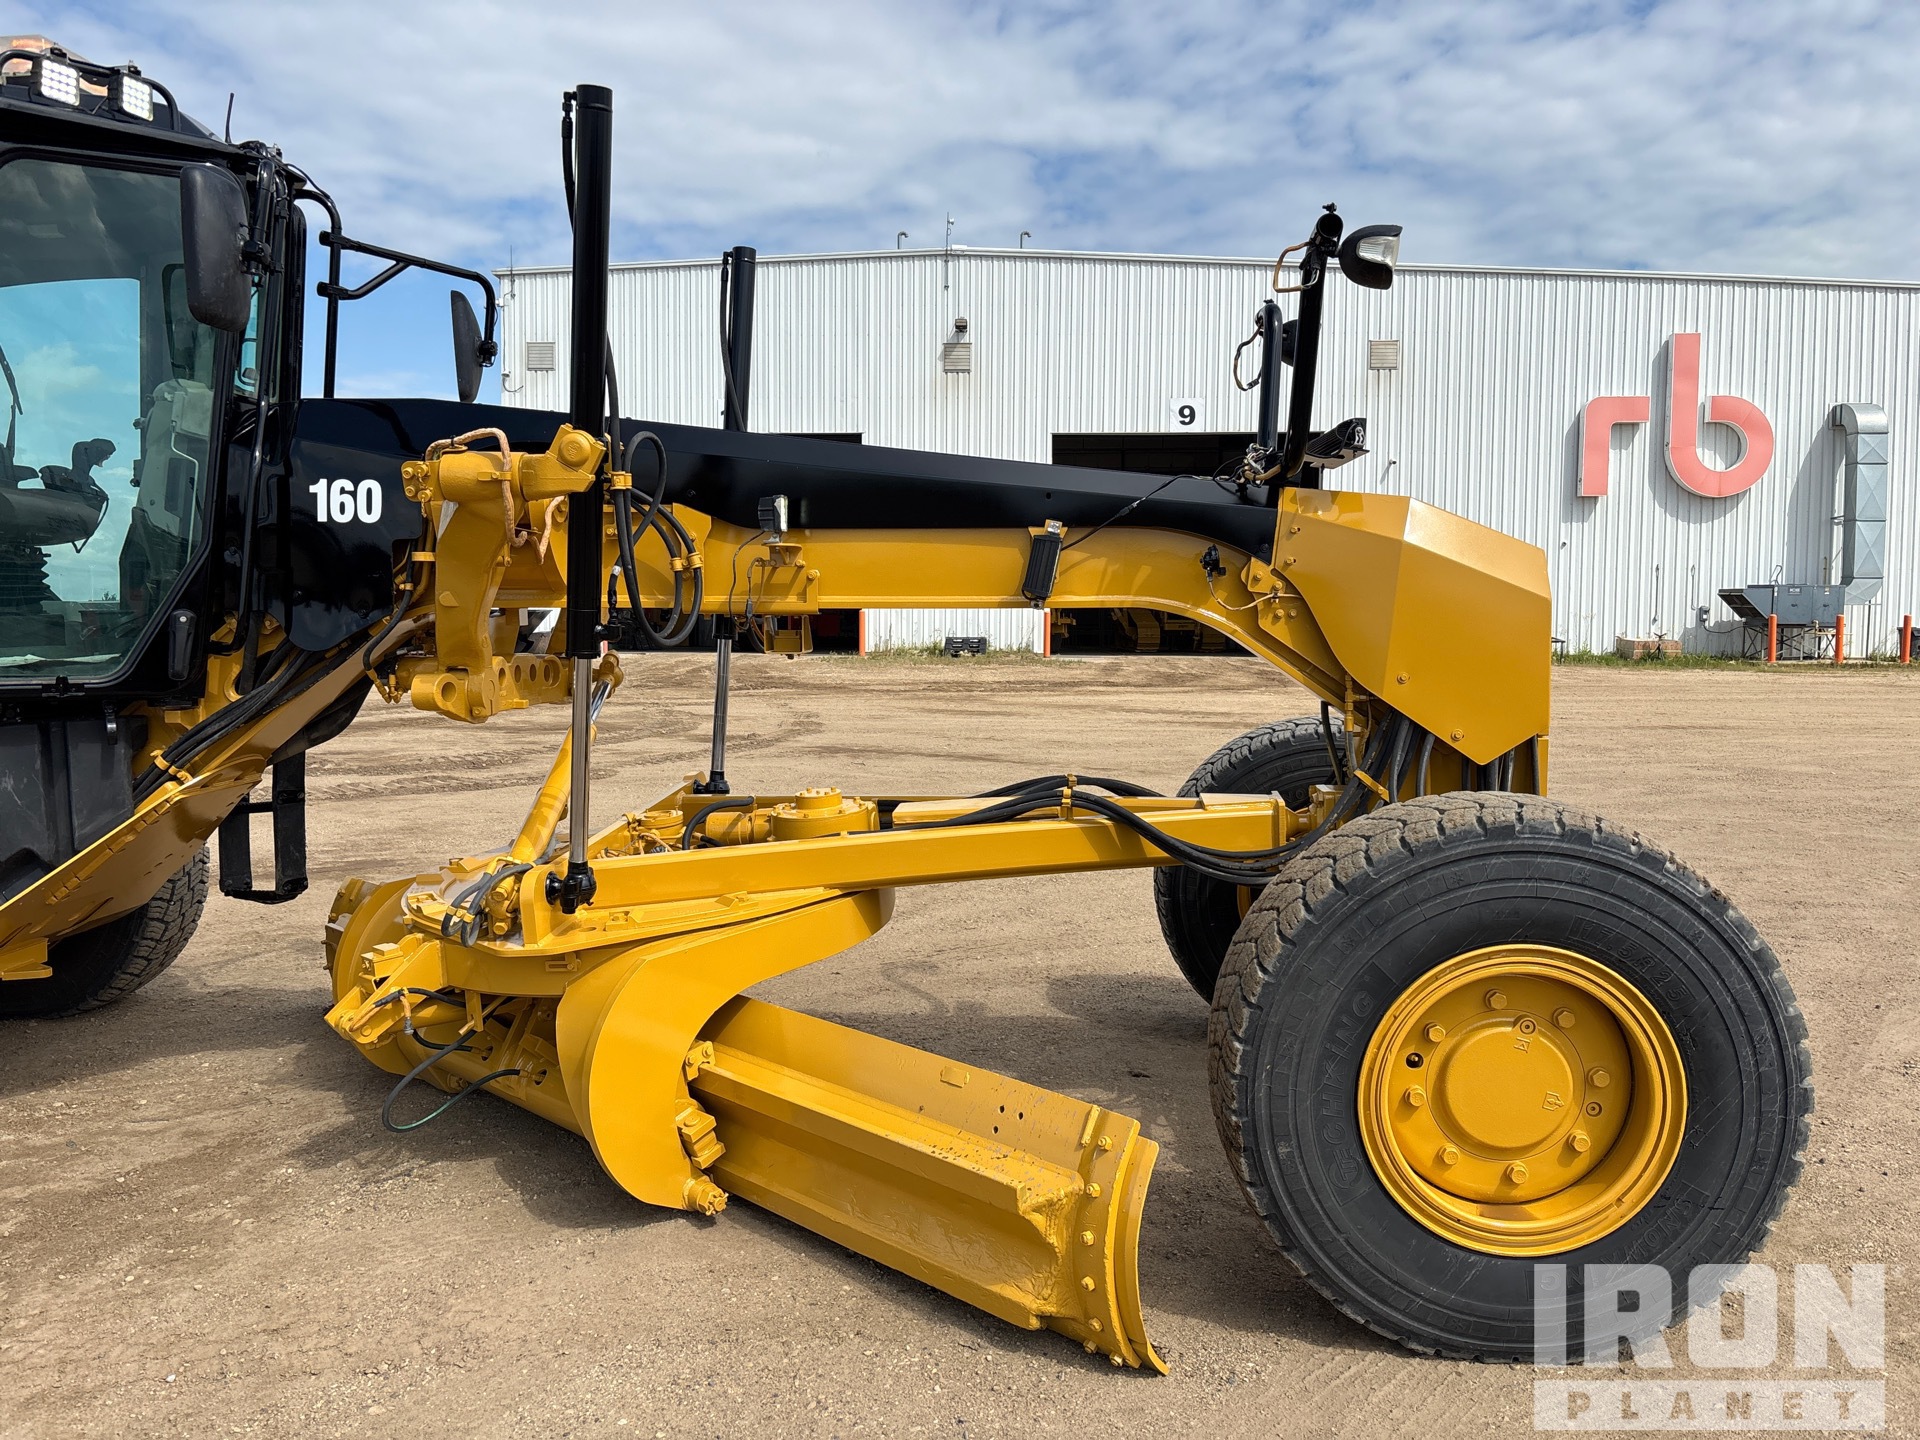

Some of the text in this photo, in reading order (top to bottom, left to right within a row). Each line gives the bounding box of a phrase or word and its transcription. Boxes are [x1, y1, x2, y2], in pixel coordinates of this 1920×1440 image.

[1178, 405, 1196, 426] 9
[1579, 333, 1774, 498] rb
[308, 479, 383, 524] 160
[1579, 921, 1690, 1002] 17.5R25
